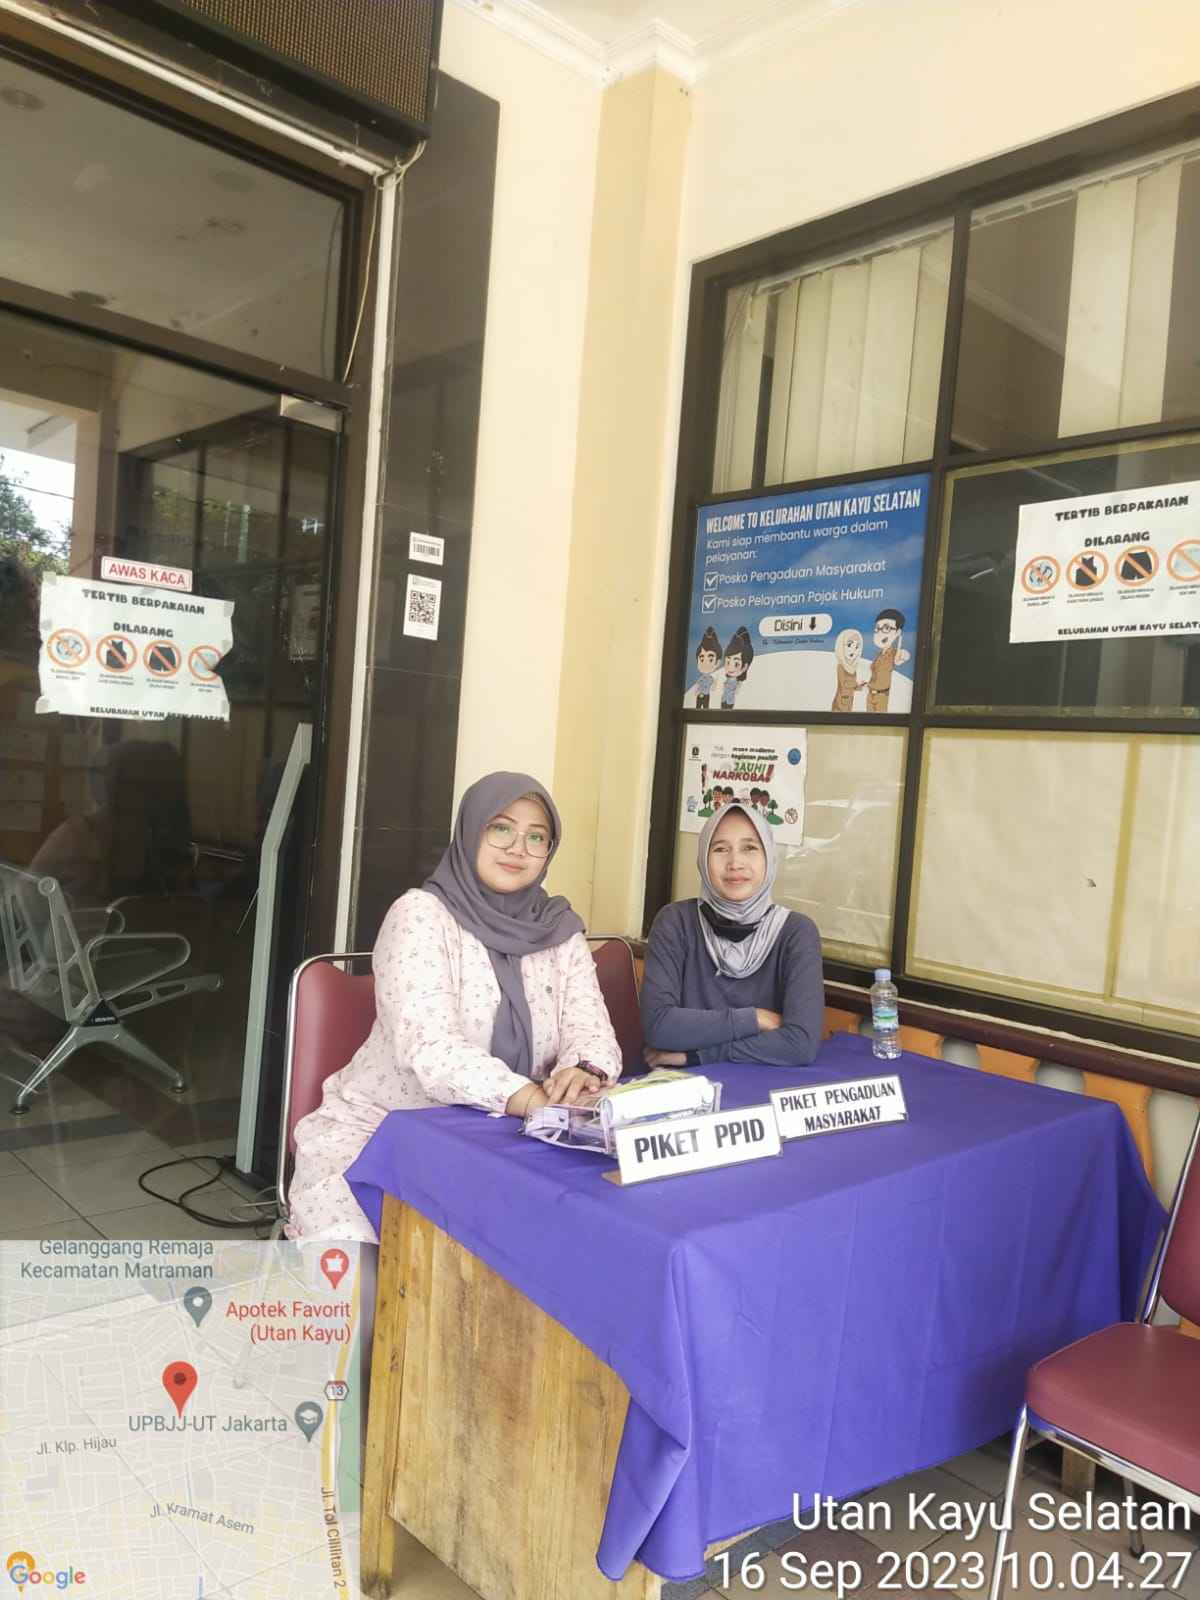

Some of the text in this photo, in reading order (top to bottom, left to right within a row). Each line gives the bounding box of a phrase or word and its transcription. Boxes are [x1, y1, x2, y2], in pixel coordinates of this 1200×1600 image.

[706, 488, 921, 534] WELCOME TO KELURAHAN UTAN KAYU SELATAN
[1055, 495, 1189, 521] TERTIB BERPAKAIAN
[706, 519, 888, 550] Kami siap membantu warga dalam
[1084, 531, 1150, 547] DILARANG
[109, 563, 186, 586] AWAS KACA
[718, 559, 887, 586] Posko Pengaduan Masyarakat
[82, 588, 205, 615] TERTIB BERPAKAIAN
[717, 586, 884, 608] Posko Pelayanan Pojok Hukum
[113, 622, 174, 638] DILARANG
[774, 618, 803, 632] Disini
[1057, 626, 1109, 636] KELURAHAN
[1111, 624, 1137, 633] UTAN
[1139, 623, 1166, 631] KAYU
[734, 762, 766, 773] JAUHI
[780, 1081, 896, 1112] PIKET PENGADUAN
[804, 1106, 881, 1132] MASYARAKAT
[633, 1118, 765, 1163] PIKET PPID
